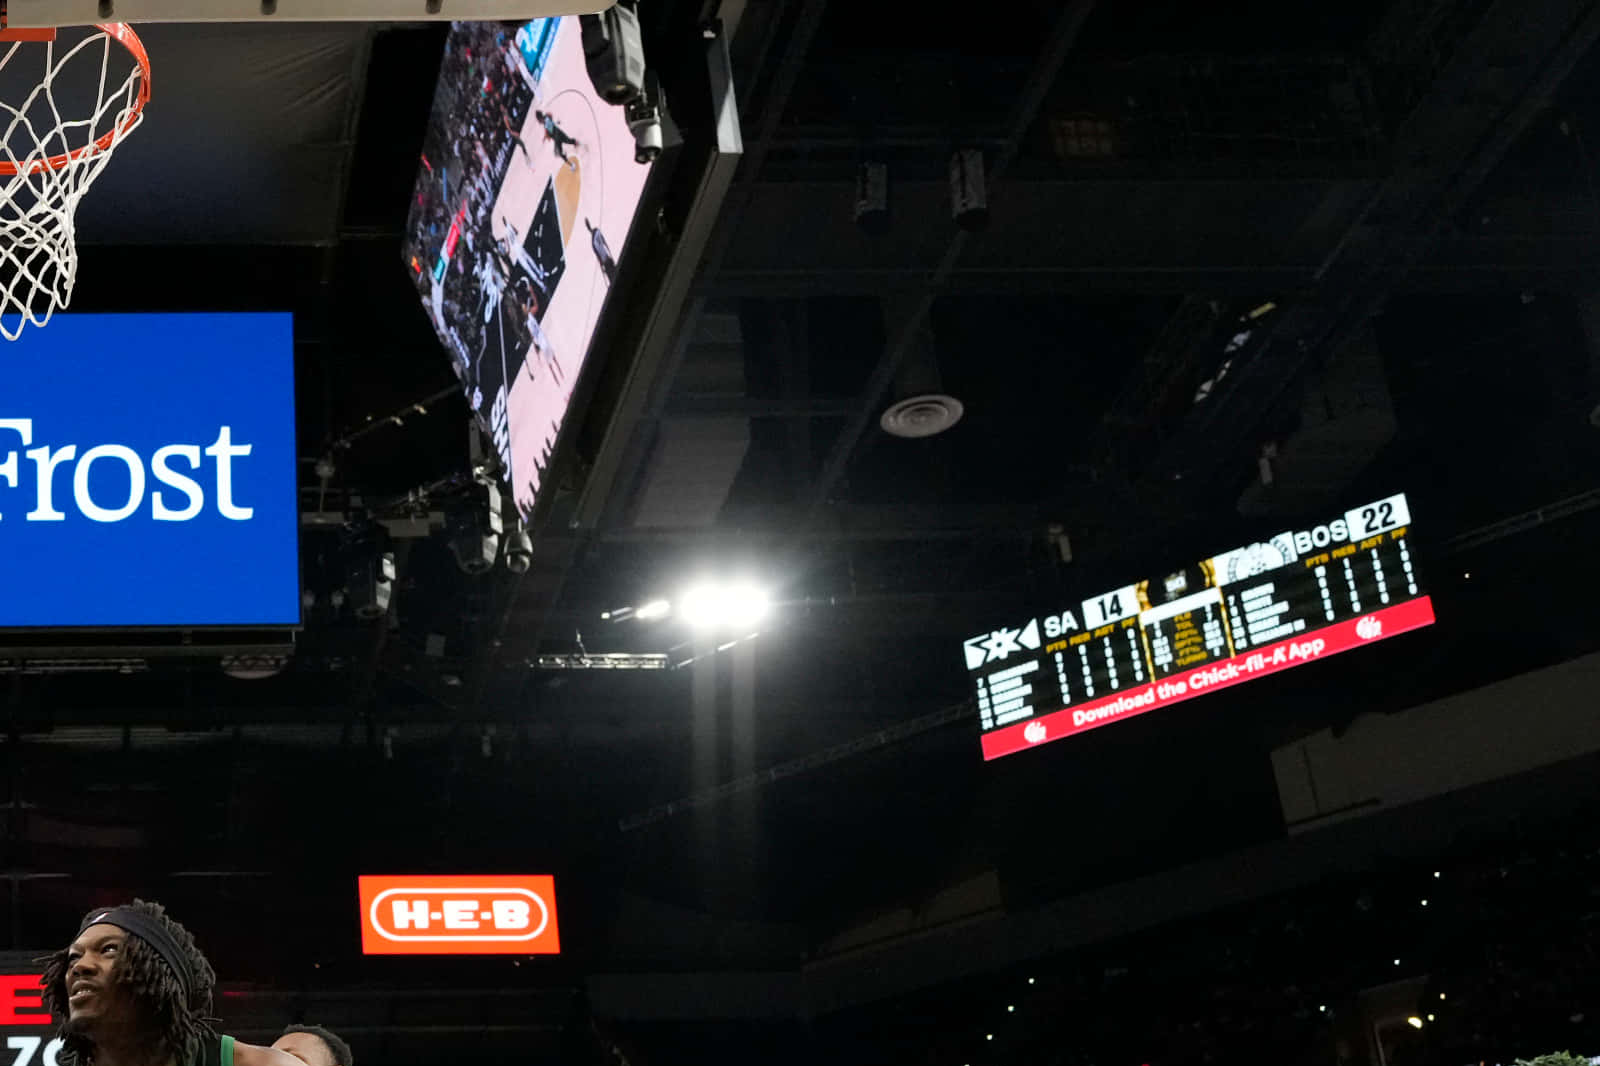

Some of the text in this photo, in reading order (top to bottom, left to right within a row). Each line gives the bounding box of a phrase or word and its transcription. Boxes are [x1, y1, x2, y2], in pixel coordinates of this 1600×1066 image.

[1294, 502, 1395, 554] BOS 22
[1044, 594, 1123, 638] SA 14
[1073, 637, 1325, 727] Download the Chick-fil-A App
[392, 900, 530, 929] H-E-B
